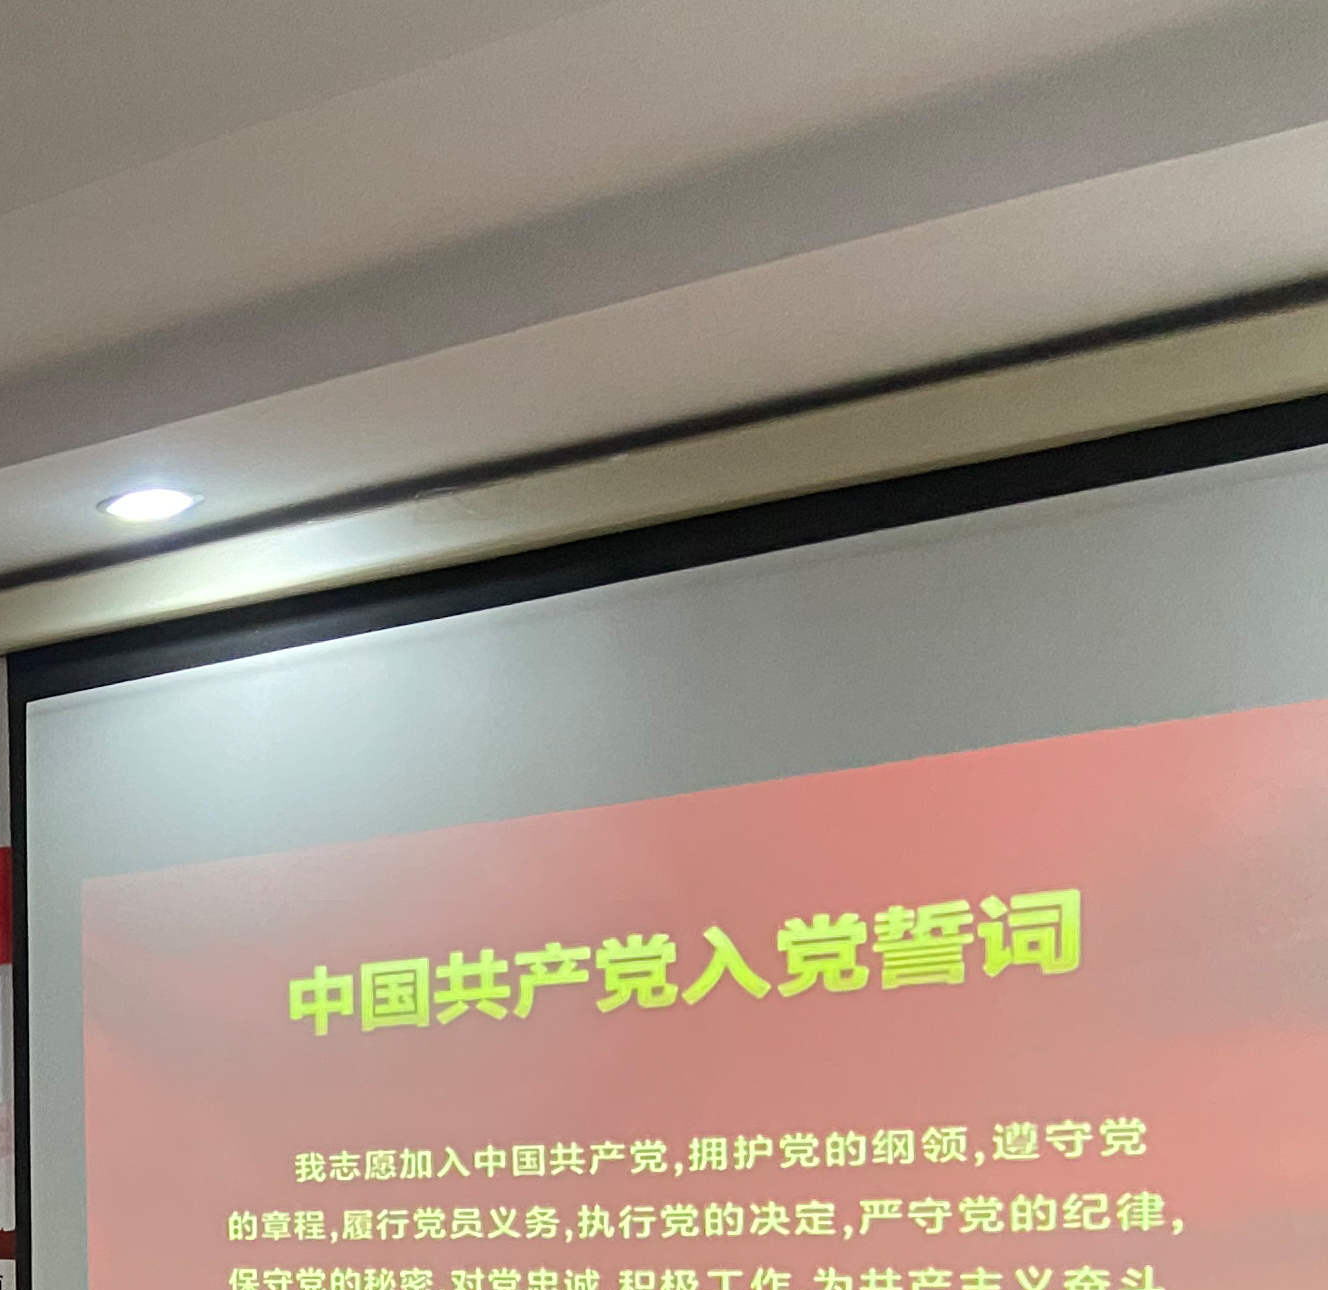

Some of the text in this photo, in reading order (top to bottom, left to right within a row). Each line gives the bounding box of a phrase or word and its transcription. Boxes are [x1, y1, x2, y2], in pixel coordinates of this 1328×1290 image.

[289, 888, 1081, 1036] 中国共产党入党誓词
[295, 1117, 1147, 1183] 我志愿加入中国共产党，拥护党的纲领，遵守党
[227, 1191, 1184, 1242] 的章程，履行党员义务，执行党的决定，严守党的纪律，
